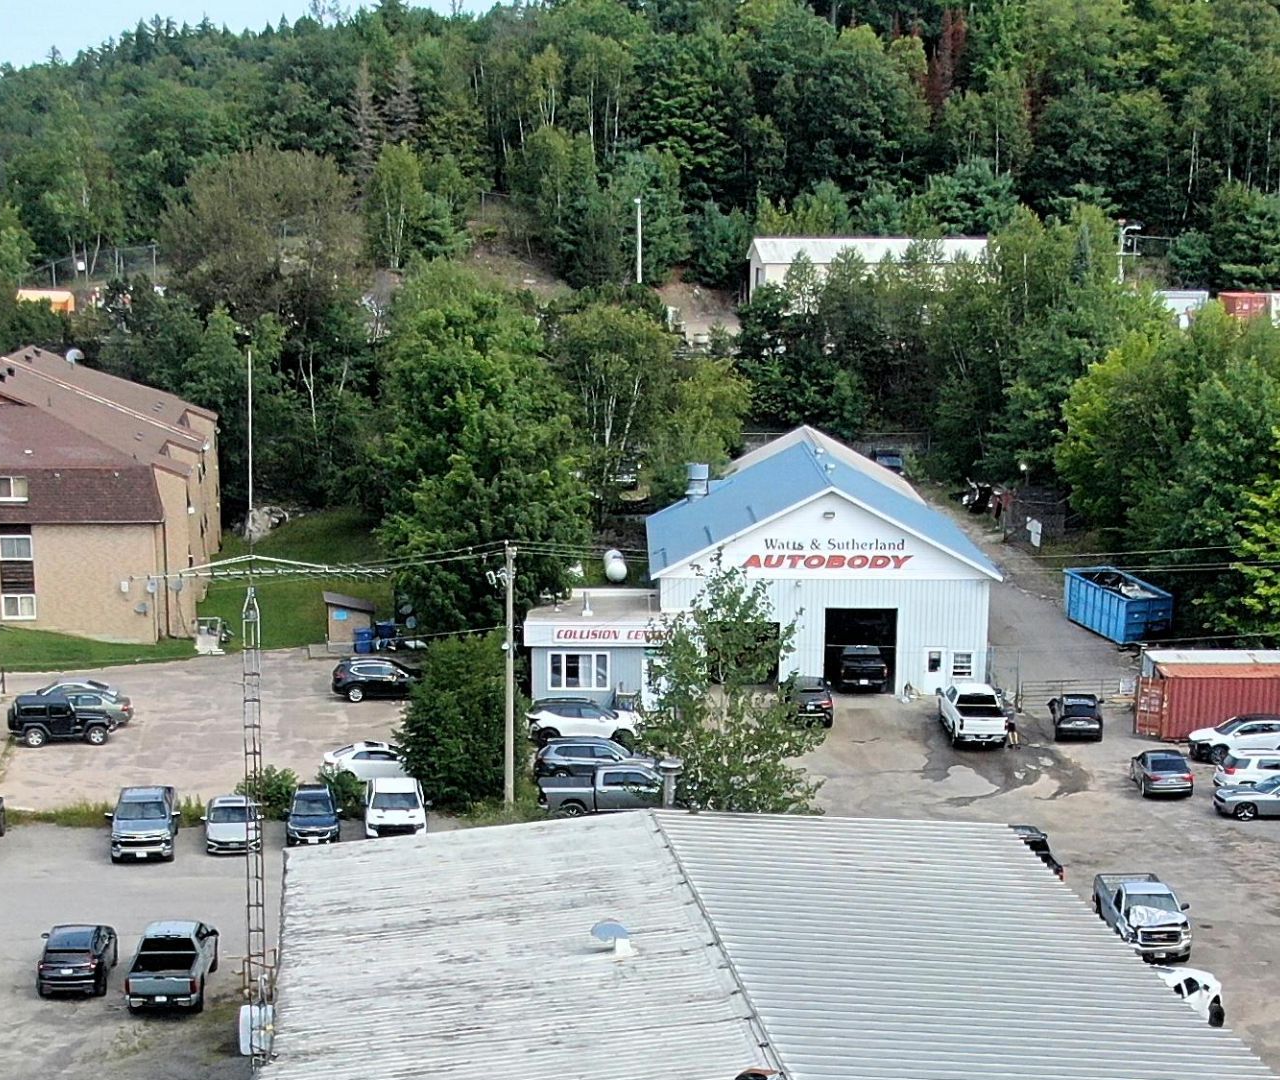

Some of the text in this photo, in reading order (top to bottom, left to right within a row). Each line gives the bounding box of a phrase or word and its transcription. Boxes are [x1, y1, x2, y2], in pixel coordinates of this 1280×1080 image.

[764, 538, 905, 550] Watts & Sutherland
[740, 554, 914, 569] AUTOBODY
[556, 629, 620, 640] COLLISION
